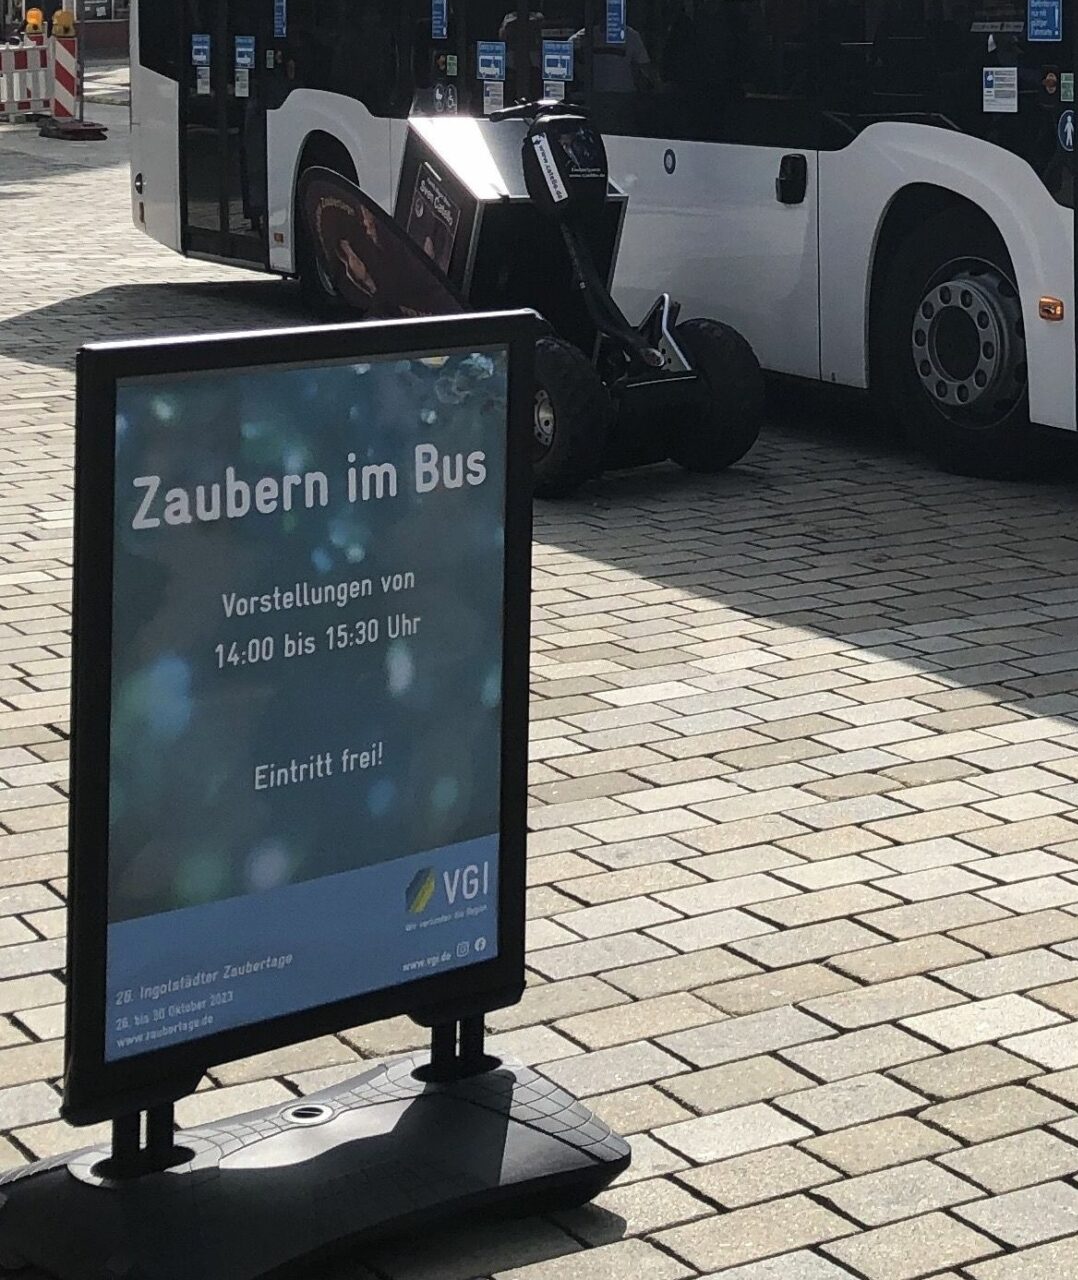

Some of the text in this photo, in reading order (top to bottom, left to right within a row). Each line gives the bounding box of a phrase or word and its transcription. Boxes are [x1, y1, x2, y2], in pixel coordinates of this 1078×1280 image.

[131, 443, 487, 530] Zaubern im Bus
[222, 571, 415, 618] Vorstellungen von
[215, 613, 421, 669] 14:00 bis 15:30 Uhr
[254, 741, 384, 790] Eintritt frei!
[442, 860, 489, 904] VGI
[140, 969, 219, 1001] Ingolstädter
[222, 953, 294, 980] Zaubertage
[116, 1014, 214, 1049] www.zaubertage.de
[168, 999, 207, 1018] Oktober
